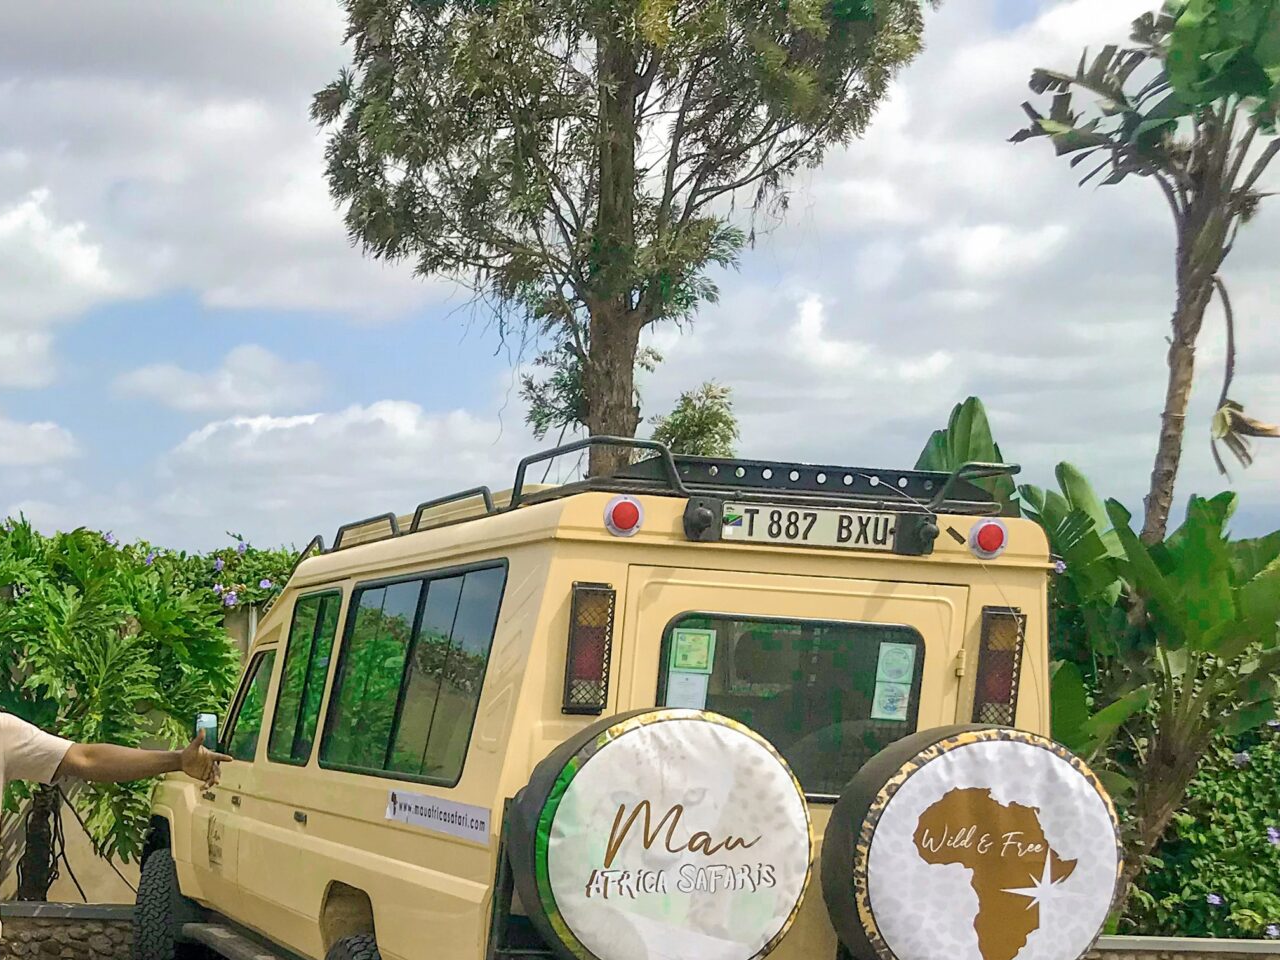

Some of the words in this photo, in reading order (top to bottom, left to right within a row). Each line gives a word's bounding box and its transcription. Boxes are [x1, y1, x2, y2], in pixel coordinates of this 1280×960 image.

[744, 508, 759, 537] T
[767, 510, 818, 540] 887
[836, 514, 889, 545] BXU
[398, 801, 486, 832] www.mauafricasafari.com
[603, 800, 762, 869] Mau
[922, 823, 973, 853] Wild
[977, 833, 993, 854] &
[1000, 831, 1044, 857] Free
